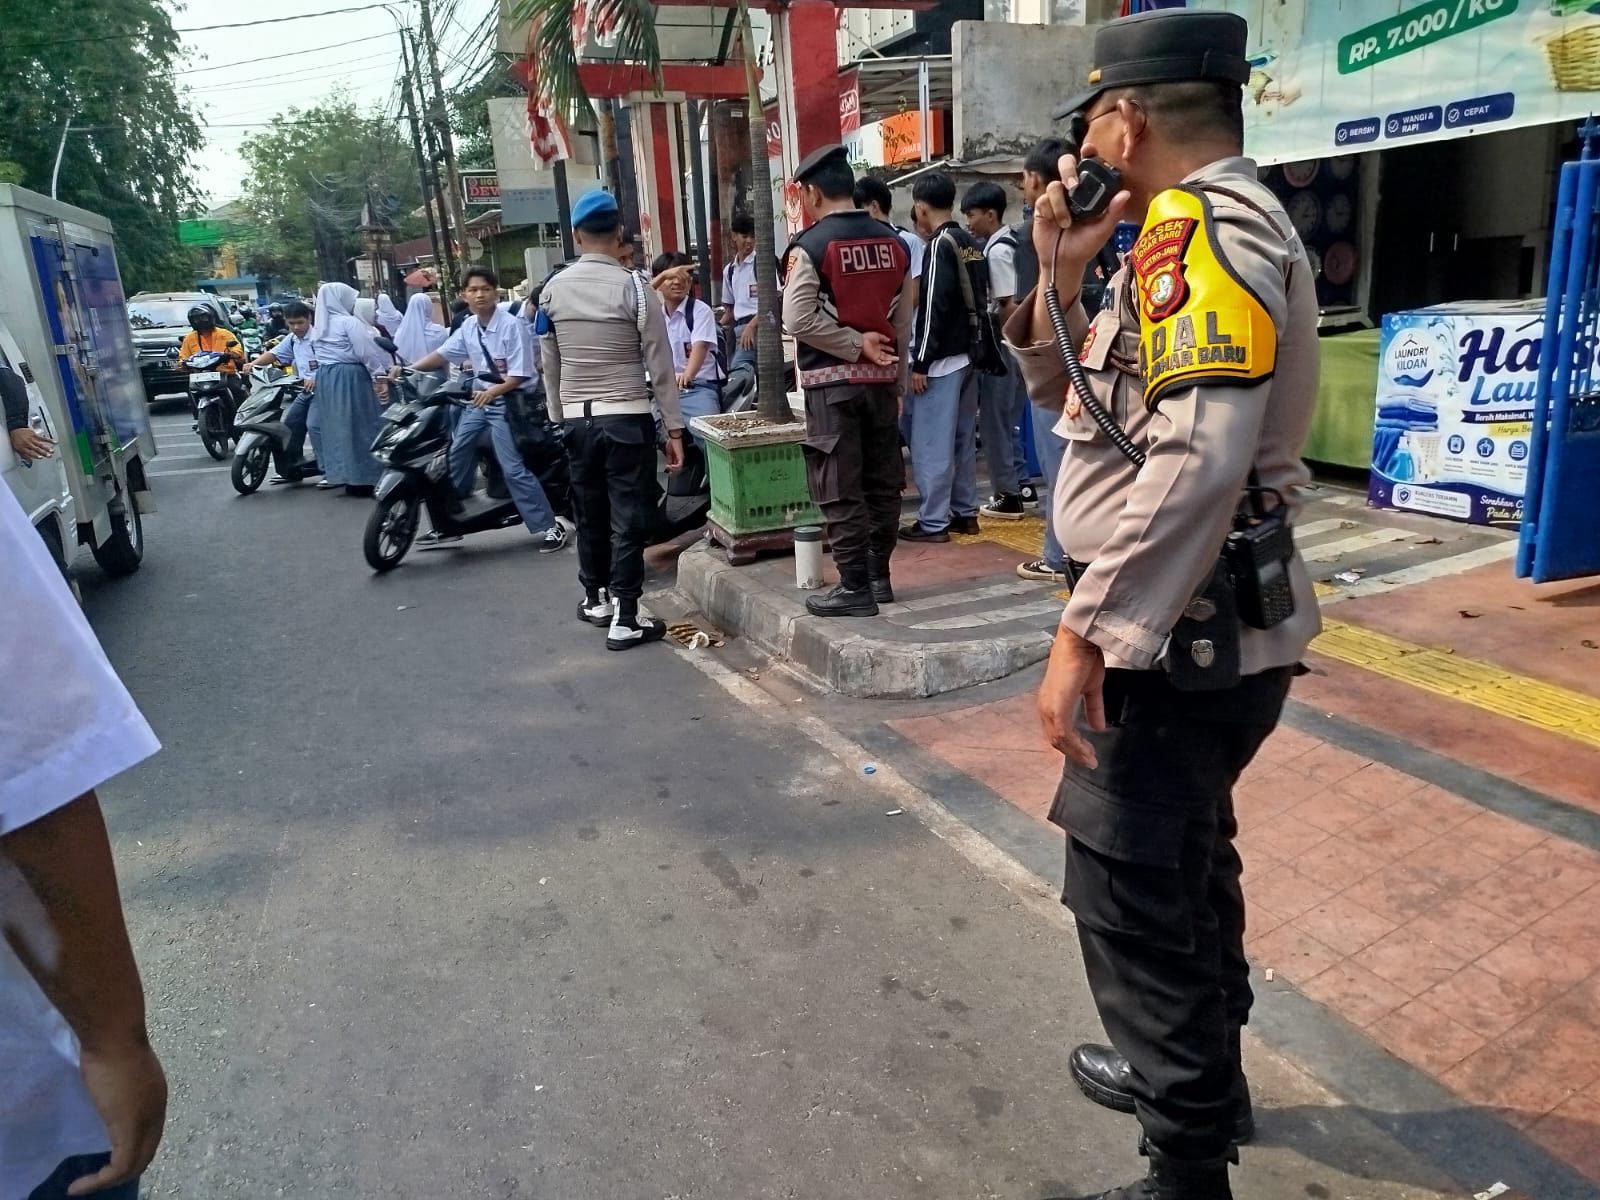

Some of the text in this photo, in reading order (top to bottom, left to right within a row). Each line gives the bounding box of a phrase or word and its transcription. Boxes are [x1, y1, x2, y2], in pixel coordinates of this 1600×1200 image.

[1349, 36, 1381, 65] RP.
[1463, 105, 1490, 117] CEPAT
[1402, 113, 1427, 124] WANGI
[1349, 126, 1375, 137] BERSIH
[1402, 124, 1419, 133] RAPI
[840, 244, 896, 272] POLISI
[1198, 345, 1246, 364] BARU
[1395, 346, 1429, 359] LAUNDRY
[1396, 358, 1428, 370] KILOAN
[1486, 507, 1509, 519] Pada
